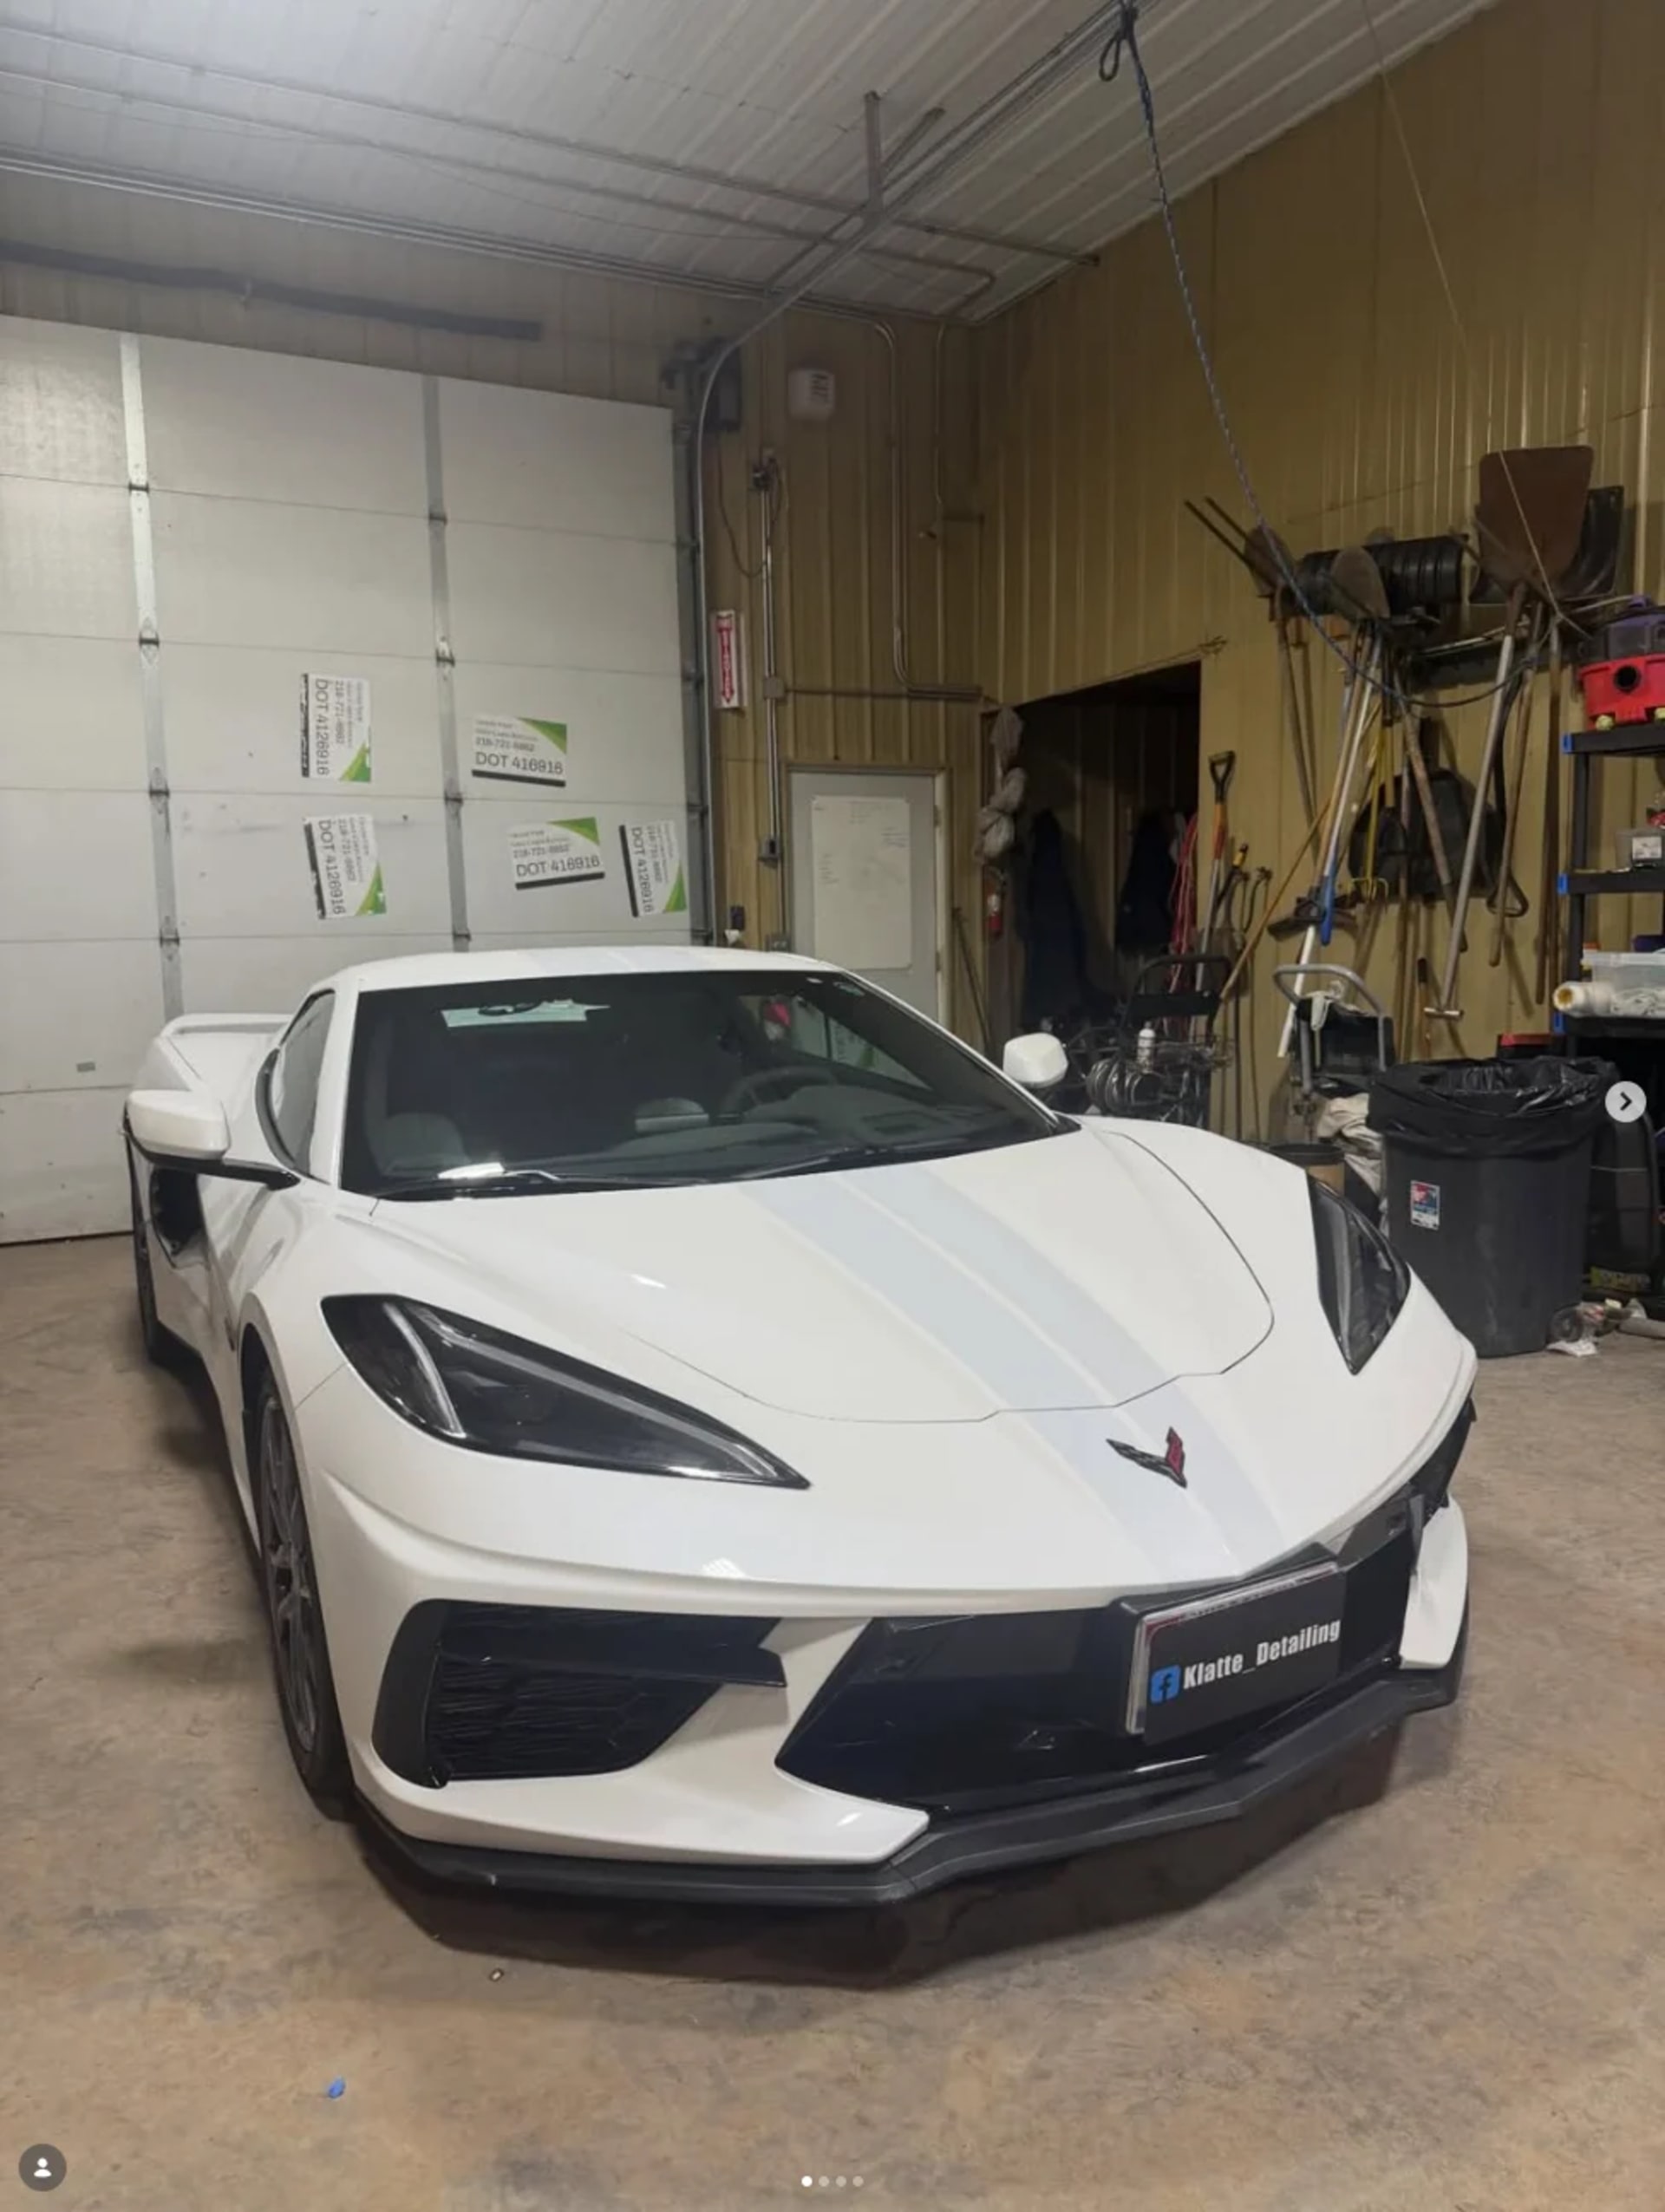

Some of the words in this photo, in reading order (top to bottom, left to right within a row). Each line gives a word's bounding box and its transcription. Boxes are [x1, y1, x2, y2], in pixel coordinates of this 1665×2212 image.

[315, 678, 329, 712] DOT
[316, 714, 330, 776] 4126916
[475, 751, 508, 768] DOT
[318, 819, 336, 852] DOT
[631, 826, 646, 857] DOT
[516, 861, 547, 878] DOT
[551, 855, 600, 872] 416916
[326, 855, 347, 915] 4126916
[1183, 1619, 1342, 1689] Klatte_Detailing
